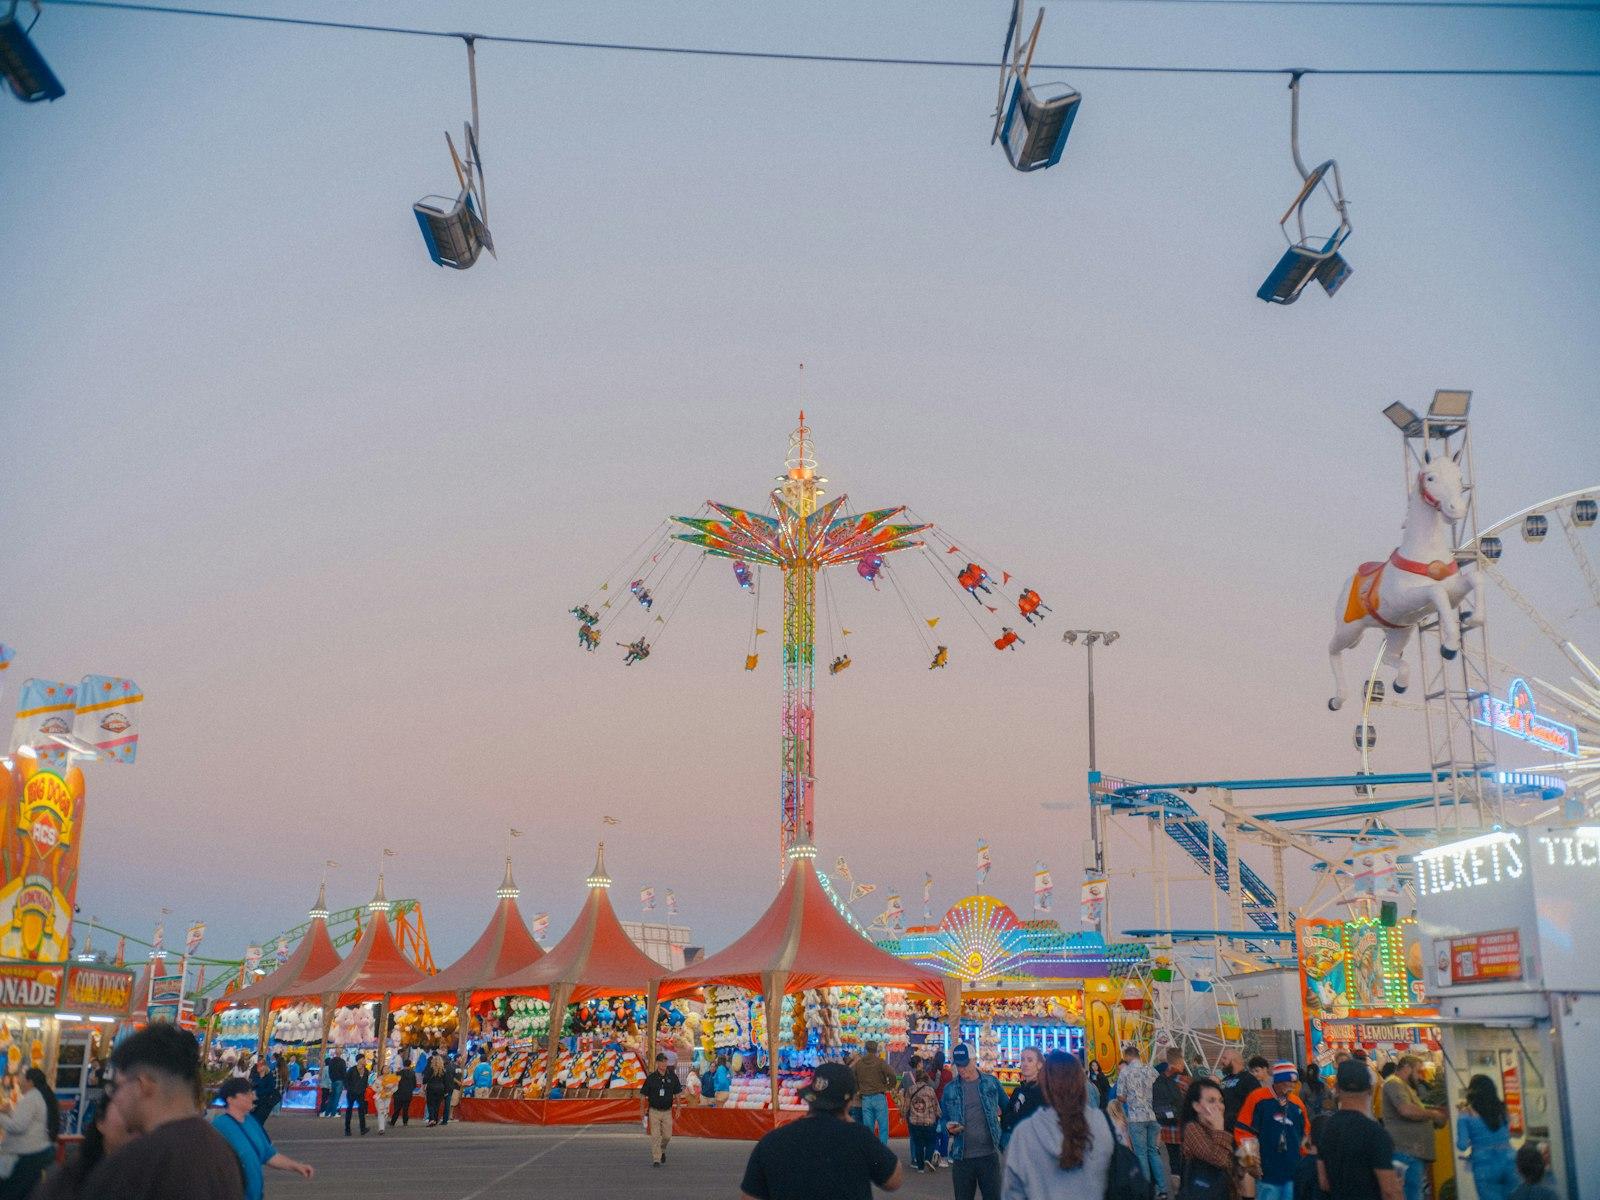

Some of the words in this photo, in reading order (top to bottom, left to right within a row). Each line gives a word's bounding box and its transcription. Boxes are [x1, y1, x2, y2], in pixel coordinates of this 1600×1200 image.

[27, 777, 45, 805] BIG
[32, 822, 58, 846] RCS
[1413, 832, 1523, 896] TICKETS
[1539, 836, 1600, 866] TIC
